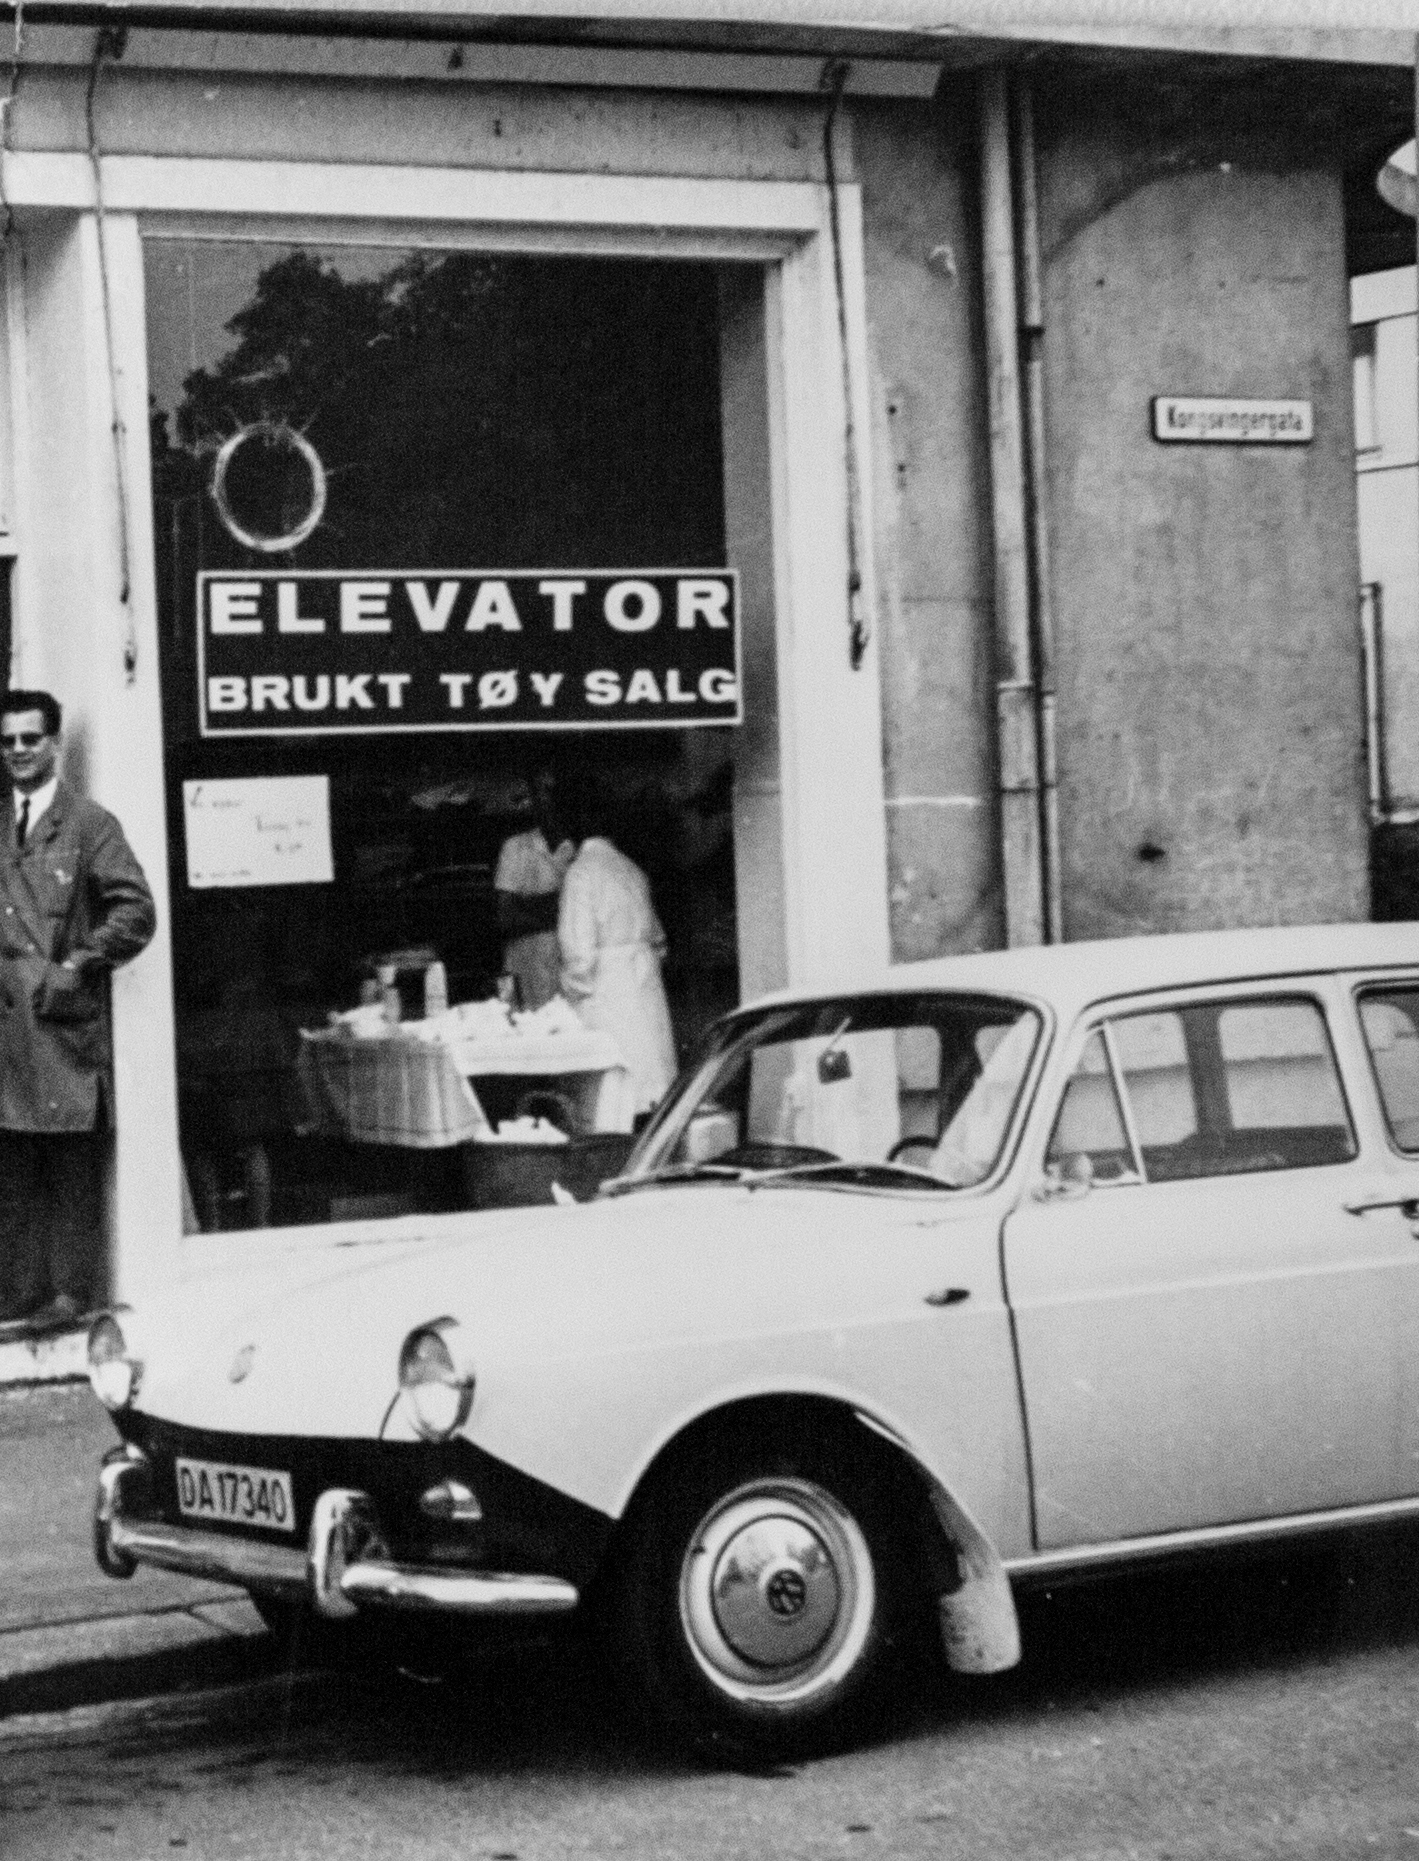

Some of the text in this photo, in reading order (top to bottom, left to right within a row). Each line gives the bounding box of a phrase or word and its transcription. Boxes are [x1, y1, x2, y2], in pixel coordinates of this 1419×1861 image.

[209, 579, 730, 635] ELEVATOR
[207, 668, 738, 712] BRUKT TØY SALG
